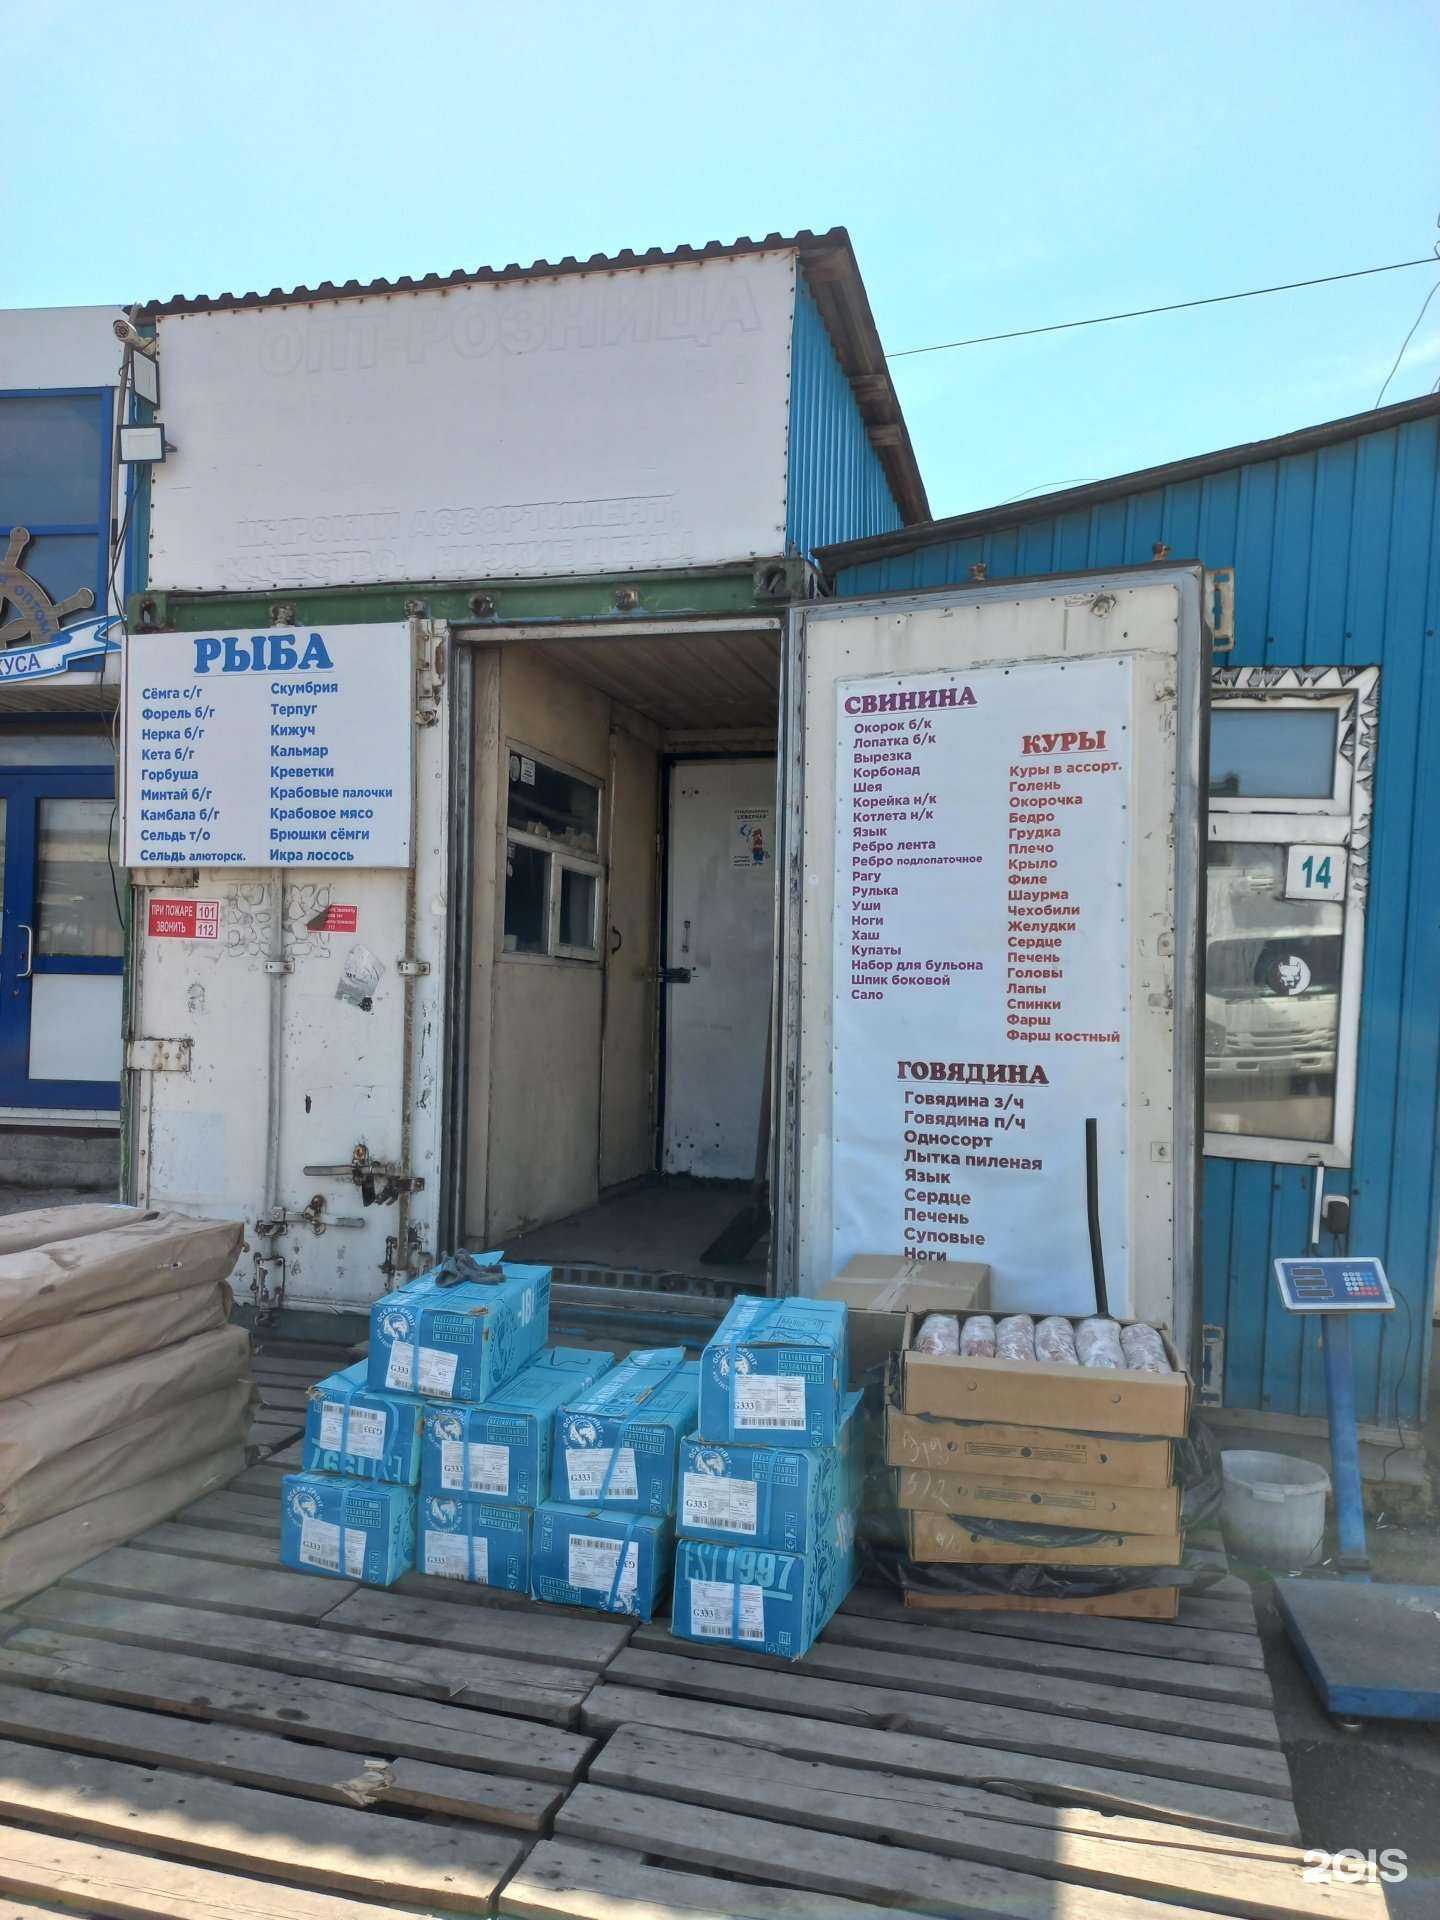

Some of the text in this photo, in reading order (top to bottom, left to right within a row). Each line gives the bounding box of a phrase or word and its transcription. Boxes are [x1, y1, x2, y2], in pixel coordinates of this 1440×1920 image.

[193, 633, 333, 673] РЫБА
[142, 686, 202, 700] Сёмга с/г
[271, 682, 338, 696] Скумбрия
[844, 687, 977, 715] СВИНИНА
[142, 706, 215, 721] Форель б/г
[271, 704, 317, 717] Терпуг
[271, 724, 315, 738] Кижуч
[854, 718, 931, 734] Окорок б/к
[142, 726, 204, 742] Нерка б/г
[853, 732, 936, 748] Лопатка б/к
[1022, 731, 1106, 754] КУРЫ
[142, 747, 194, 761] Кета б/г
[271, 745, 328, 758] Кальмар
[854, 752, 911, 764] Вырезка
[142, 769, 198, 782] Горбуша
[271, 766, 334, 780] Креветки
[854, 766, 920, 779] Корбонад
[1010, 762, 1122, 778] Куры в ассорт.
[854, 782, 882, 792] Шея
[1010, 781, 1061, 792] Голень
[142, 788, 212, 801] Минтай б/г
[271, 787, 392, 800] Крабовые палочки
[853, 793, 936, 808] Корейка н/к
[1009, 796, 1082, 808] Окорочка
[141, 808, 219, 822] Камбала б/г
[270, 807, 373, 821] Крабовое мясо
[853, 808, 933, 822] Котлета н/к
[1009, 813, 1054, 824] Бедро
[141, 828, 210, 842] Сельдь т/о
[270, 828, 369, 842] Брюшки сёмги
[853, 827, 887, 837] Язык
[1009, 828, 1061, 840] Грудка
[853, 841, 936, 853] Ребро лента
[1009, 844, 1053, 854] Плечо
[140, 850, 246, 863] Сельдь алюторск.
[270, 849, 354, 863] Икра лосось
[853, 856, 982, 868] Ребро подлопаточное
[1009, 859, 1058, 871] Крыло
[853, 871, 881, 882] Рагу
[1302, 856, 1331, 889] 14
[1008, 874, 1047, 885] Филе
[853, 886, 898, 898] Рулька
[1008, 890, 1068, 902] Шаурма
[152, 904, 193, 917] ПРИ ПОЖАРЕ
[199, 906, 215, 919] 101
[852, 901, 880, 911] Уши
[1008, 905, 1080, 916] Чехобили
[156, 921, 186, 933] ЗВОНИТЬ
[852, 916, 883, 925] Ноги
[1008, 921, 1075, 933] Желудки
[198, 923, 214, 936] 112
[852, 930, 879, 940] Хаш
[1008, 937, 1062, 949] Сердце
[852, 945, 901, 957] Купаты
[1008, 952, 1060, 962] Печень
[852, 960, 983, 972] Набор для бульона
[1008, 967, 1062, 978] Головы
[852, 975, 950, 985] Шпик боковой
[851, 990, 883, 1000] Сало
[1006, 983, 1046, 994] Лапы
[1007, 999, 1061, 1009] Спинки
[1007, 1014, 1050, 1027] Фарш
[1007, 1030, 1120, 1042] Фарш костный
[897, 1061, 1049, 1085] ГОВЯДИНА
[905, 1091, 1024, 1110] Говядина з/ч
[905, 1111, 1025, 1130] Говядина п/ч
[904, 1130, 993, 1148] Односорт
[904, 1149, 1042, 1170] Лытка пиленая
[905, 1169, 950, 1183] Язык
[905, 1188, 971, 1206] Сердце
[905, 1208, 969, 1224] Печень
[904, 1227, 985, 1245] Суповые
[904, 1247, 947, 1262] Ноги
[391, 1364, 409, 1374] G333
[571, 1473, 591, 1481] G333
[686, 1499, 708, 1508] G333
[303, 1541, 321, 1550] G333
[694, 1608, 714, 1617] G333
